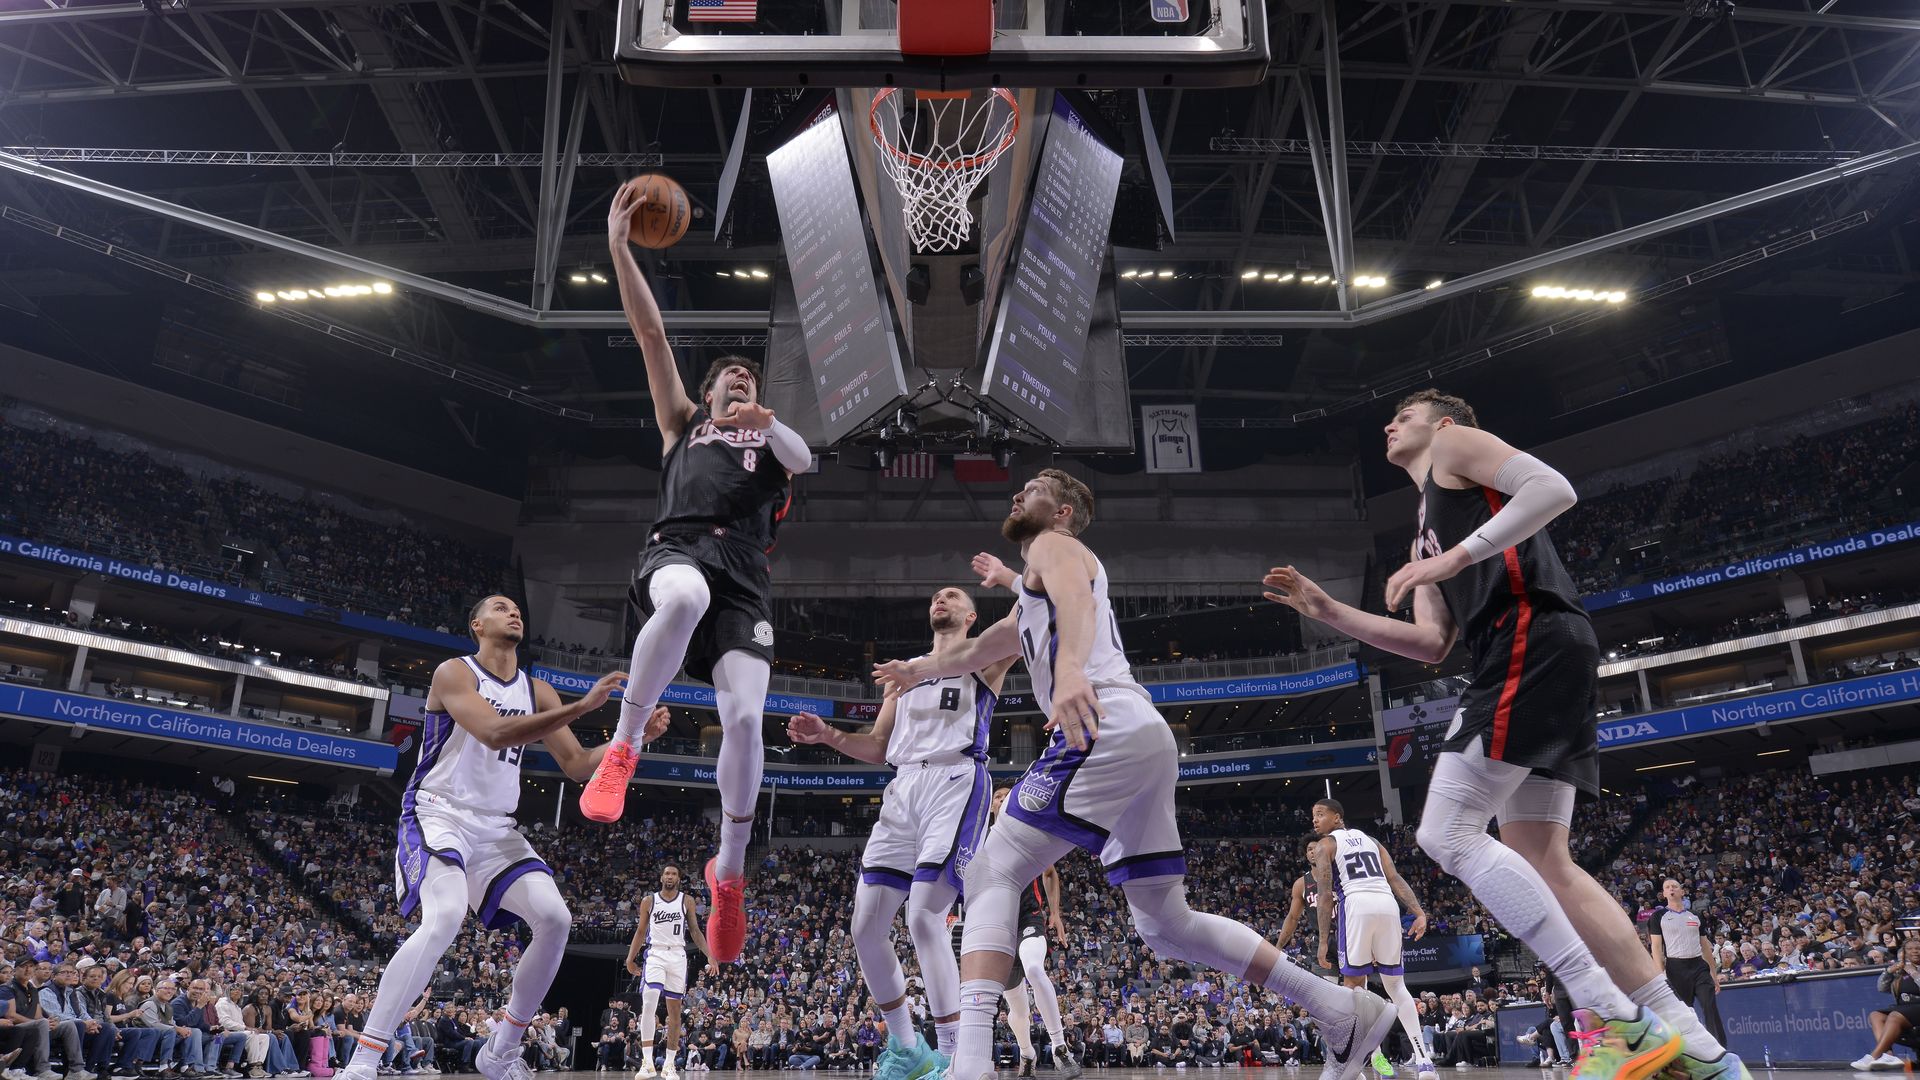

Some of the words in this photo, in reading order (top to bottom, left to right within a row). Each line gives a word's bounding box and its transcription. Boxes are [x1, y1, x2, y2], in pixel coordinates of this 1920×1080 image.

[1157, 7, 1174, 18] NBA
[1055, 141, 1077, 166] IN-GAME
[1080, 125, 1110, 160] KINGS
[1049, 203, 1062, 218] FULTZ
[1051, 191, 1067, 210] MURRAY
[1050, 222, 1062, 236] TOTALS
[814, 251, 842, 280] SHOOTING
[1024, 247, 1036, 263] FIELD
[1037, 258, 1051, 275] GOALS
[1048, 250, 1075, 280] SHOOTING
[1020, 263, 1046, 289] 3-POINTERS
[800, 296, 811, 310] FIELD
[812, 286, 824, 300] GOALS
[1017, 278, 1027, 291] FREE
[1028, 286, 1048, 308] THROWS
[803, 301, 826, 324] 3-POINTERS
[816, 312, 833, 330] THROWS
[824, 354, 834, 366] TEAM
[834, 342, 848, 357] FOULS
[864, 317, 879, 334] BONUS
[834, 323, 852, 343] FOULS
[1038, 324, 1056, 343] FOULS
[1020, 326, 1032, 339] TEAM
[1033, 335, 1046, 350] FOULS
[1063, 359, 1077, 374] BONUS
[840, 371, 868, 396] TIMEOUTS
[1022, 371, 1050, 397] TIMEOUTS
[1149, 409, 1170, 419] SIXTH
[1172, 409, 1189, 418] MAN
[1159, 434, 1184, 444] Kings
[1176, 446, 1182, 454] 6
[743, 448, 757, 472] 8
[18, 542, 103, 571] California
[108, 561, 162, 584] Honda
[167, 574, 226, 599] Dealers
[1653, 572, 1721, 595] Northern
[1726, 552, 1805, 578] California
[1809, 536, 1866, 560] Honda
[551, 675, 593, 690] HON
[664, 689, 691, 699] thern
[1176, 687, 1224, 697] Northern
[1227, 682, 1277, 694] California
[1280, 678, 1314, 690] Honda
[1317, 670, 1353, 684] Dealers
[780, 700, 817, 712] Dealers
[940, 687, 960, 711] 8
[1712, 701, 1796, 724] Northern
[1801, 682, 1896, 710] California
[54, 698, 141, 726] Northern
[148, 714, 231, 740] California
[236, 726, 292, 749] Honda
[297, 737, 356, 759] Dealers
[1596, 722, 1659, 742] NDA
[694, 769, 717, 779] Nort
[1212, 762, 1250, 774] Dealers
[761, 775, 788, 784] fornia
[792, 776, 823, 786] Honda
[826, 776, 864, 786] Dealers
[1020, 785, 1051, 802] KINGS
[1344, 852, 1384, 880] 20
[653, 910, 682, 924] Kings
[673, 924, 682, 936] 0
[1402, 948, 1437, 956] berly-Clark
[1728, 1016, 1782, 1034] California
[1784, 1010, 1830, 1032] Honda
